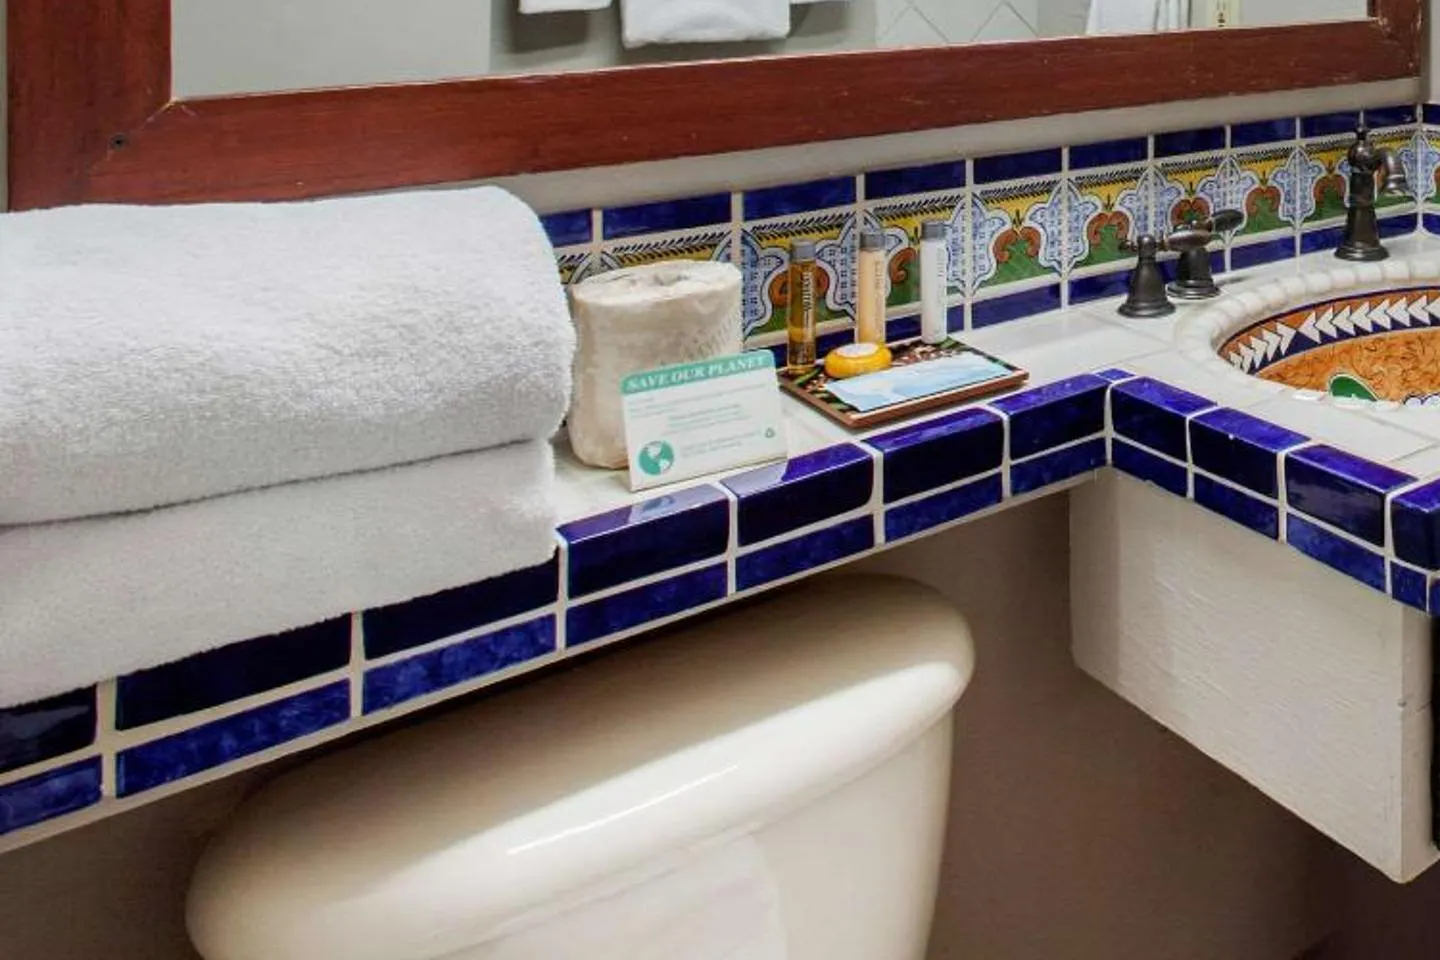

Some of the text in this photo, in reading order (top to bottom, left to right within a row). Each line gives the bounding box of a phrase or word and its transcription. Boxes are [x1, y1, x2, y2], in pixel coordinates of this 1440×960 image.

[627, 355, 765, 390] SAVE OUR PLANET
